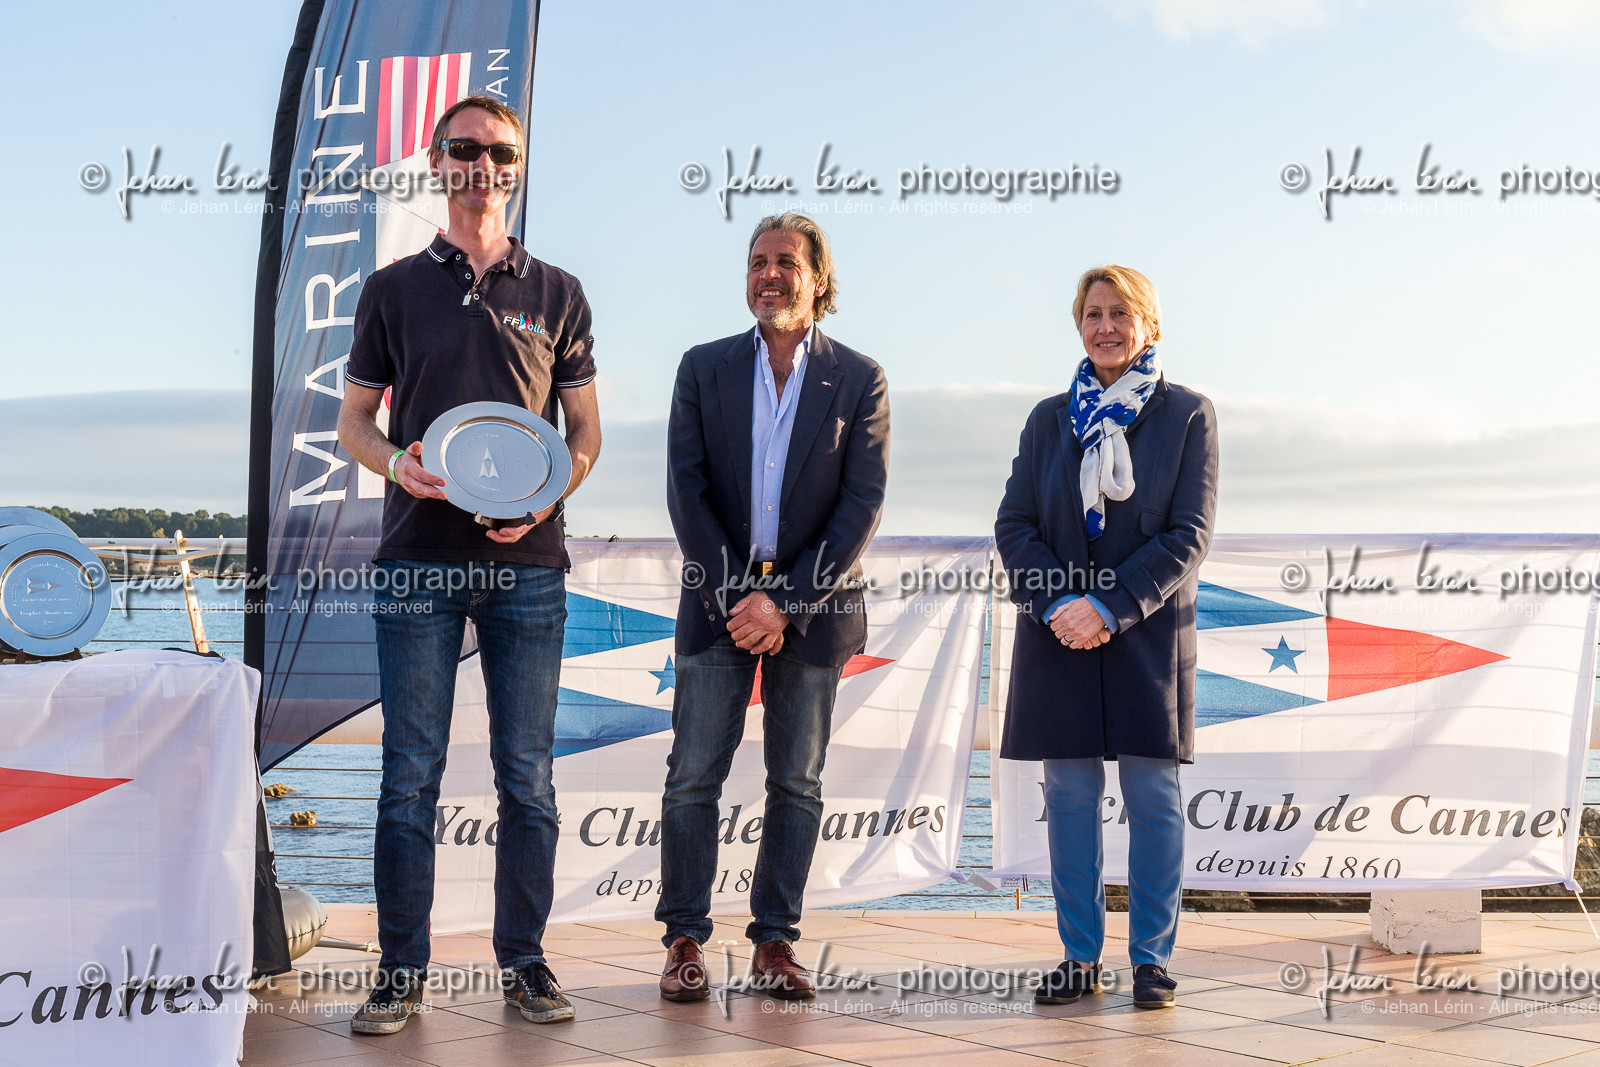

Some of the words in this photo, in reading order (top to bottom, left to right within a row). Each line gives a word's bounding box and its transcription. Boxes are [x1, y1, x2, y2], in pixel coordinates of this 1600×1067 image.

[486, 48, 511, 107] AN
[289, 60, 370, 510] MARINE
[579, 806, 663, 847] Clu
[820, 804, 947, 842] annes
[1187, 789, 1301, 832] Club
[1314, 793, 1371, 832] de
[1195, 850, 1307, 878] depuis
[1320, 855, 1402, 879] 1860
